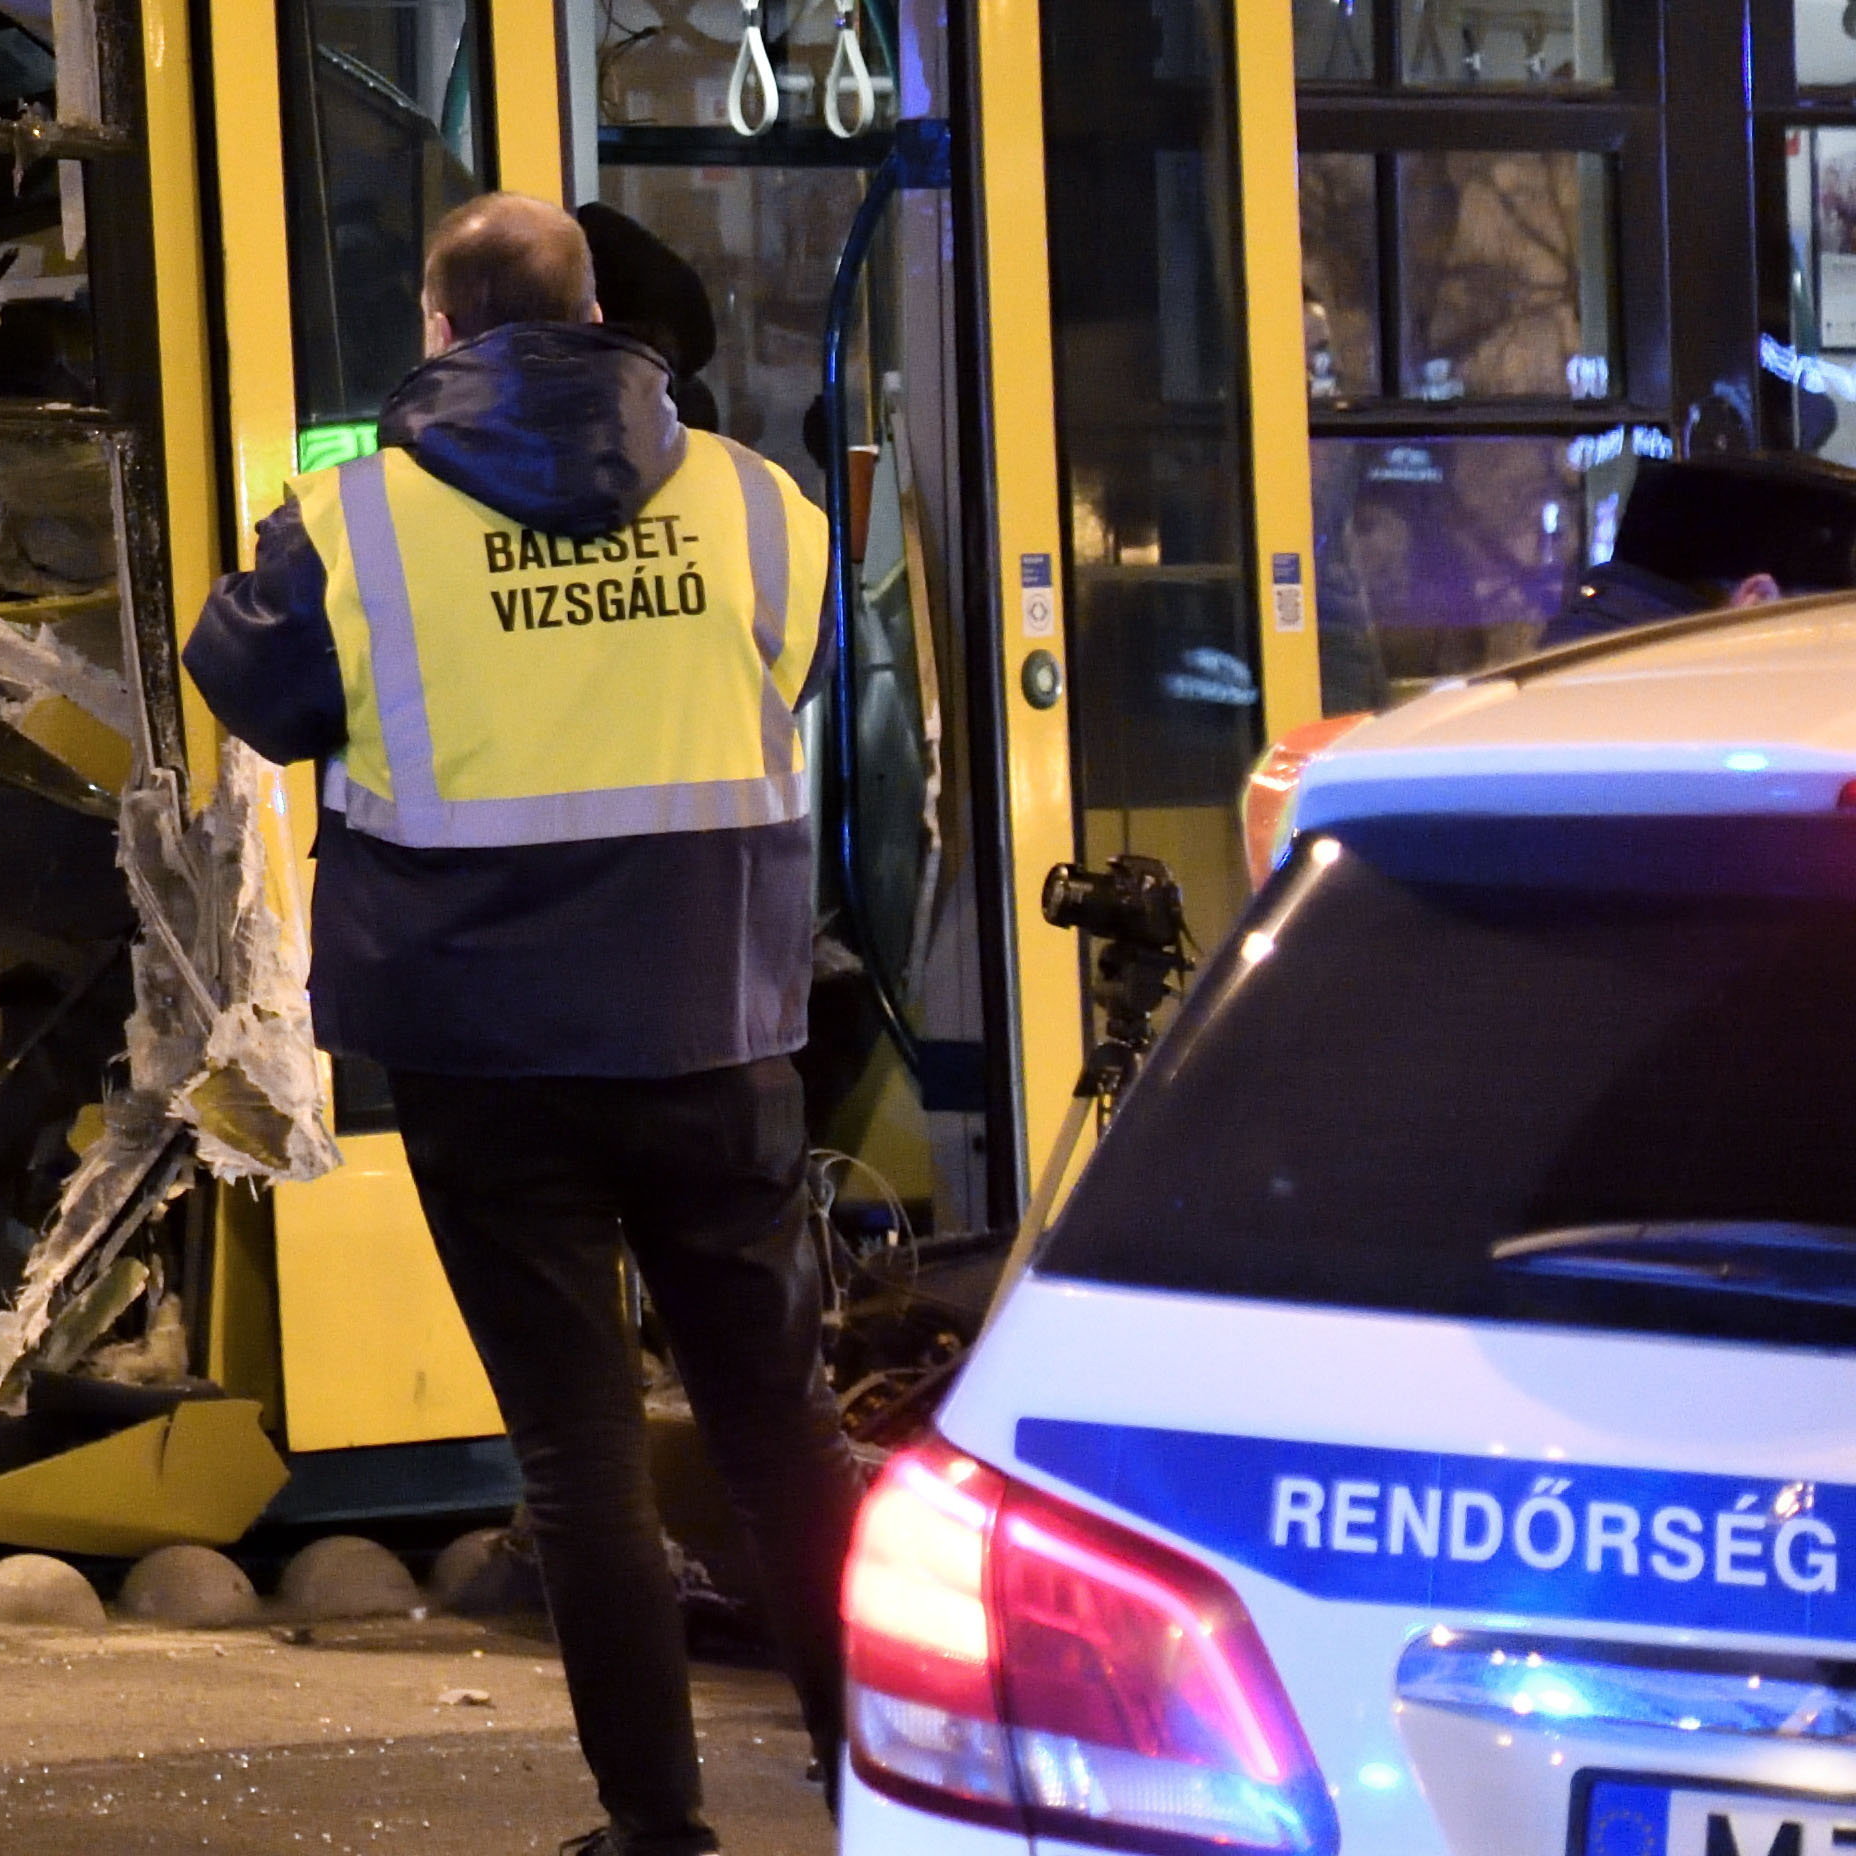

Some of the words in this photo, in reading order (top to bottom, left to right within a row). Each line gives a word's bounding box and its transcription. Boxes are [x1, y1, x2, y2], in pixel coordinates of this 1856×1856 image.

[484, 515, 699, 573] BALESET-
[490, 562, 707, 633] VIZSGÁLÓ
[1269, 1478, 1839, 1593] RENDŐRSÉG
